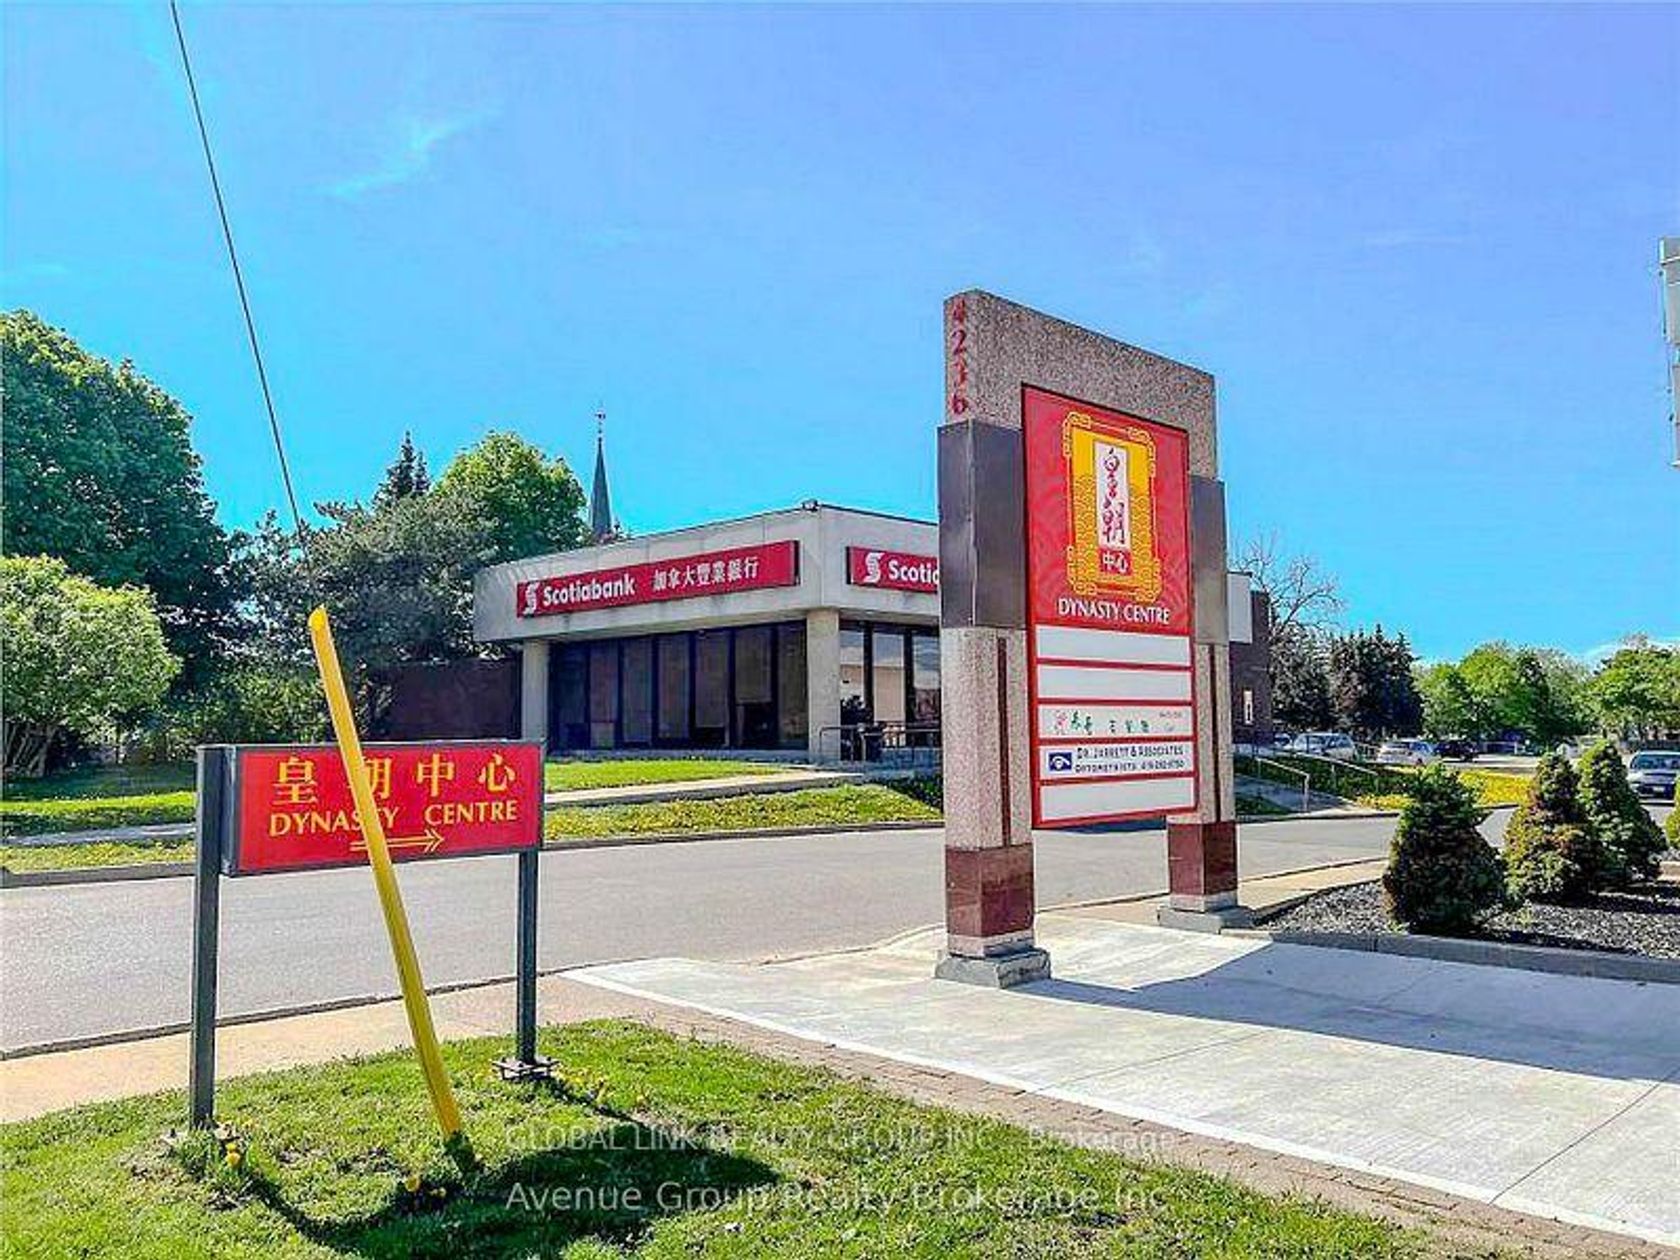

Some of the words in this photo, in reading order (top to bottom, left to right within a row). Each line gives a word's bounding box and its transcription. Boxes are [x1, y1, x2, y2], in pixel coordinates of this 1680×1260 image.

[542, 573, 636, 607] Scotiabank
[1057, 597, 1121, 620] DYNASTY
[1122, 604, 1171, 625] CENTRE
[269, 806, 399, 837] DYNASY
[424, 799, 518, 826] CENTRE
